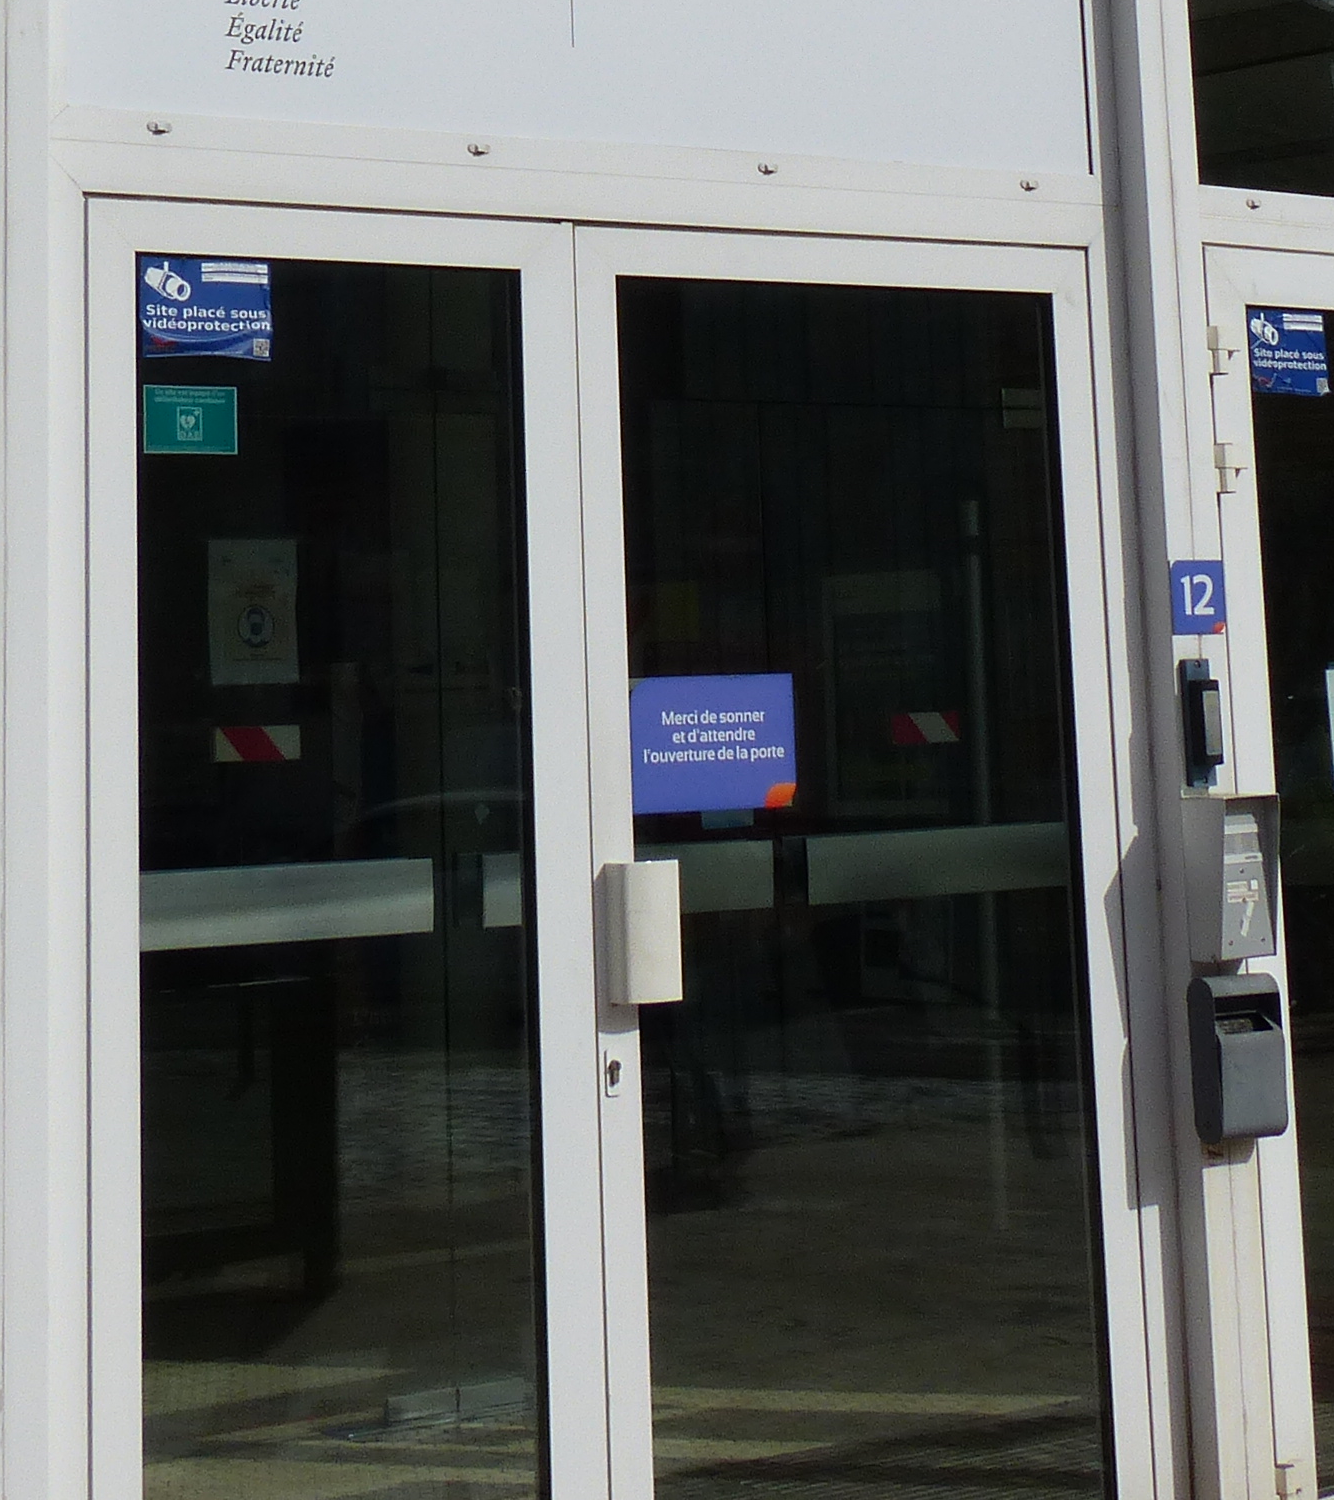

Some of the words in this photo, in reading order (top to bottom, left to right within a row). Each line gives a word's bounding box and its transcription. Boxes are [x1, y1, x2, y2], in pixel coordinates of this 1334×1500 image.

[224, 11, 304, 45] Égalité
[224, 49, 336, 79] Fraternité
[146, 303, 178, 316] Site
[183, 306, 226, 319] placé
[230, 309, 267, 319] sous
[142, 317, 271, 332] vidéoprotection
[1253, 347, 1273, 358] Site
[1274, 348, 1300, 360] placé
[1302, 351, 1325, 360] sous
[1252, 358, 1327, 371] vidéoprotection
[1180, 574, 1215, 616] 12
[661, 709, 698, 726] Merci
[700, 709, 717, 725] de
[719, 710, 765, 724] sonner
[672, 731, 686, 744] et
[688, 727, 756, 743] d'attendre
[643, 748, 715, 764] l'ouverture
[717, 746, 734, 760] de
[736, 746, 748, 759] la
[750, 745, 785, 763] porte
